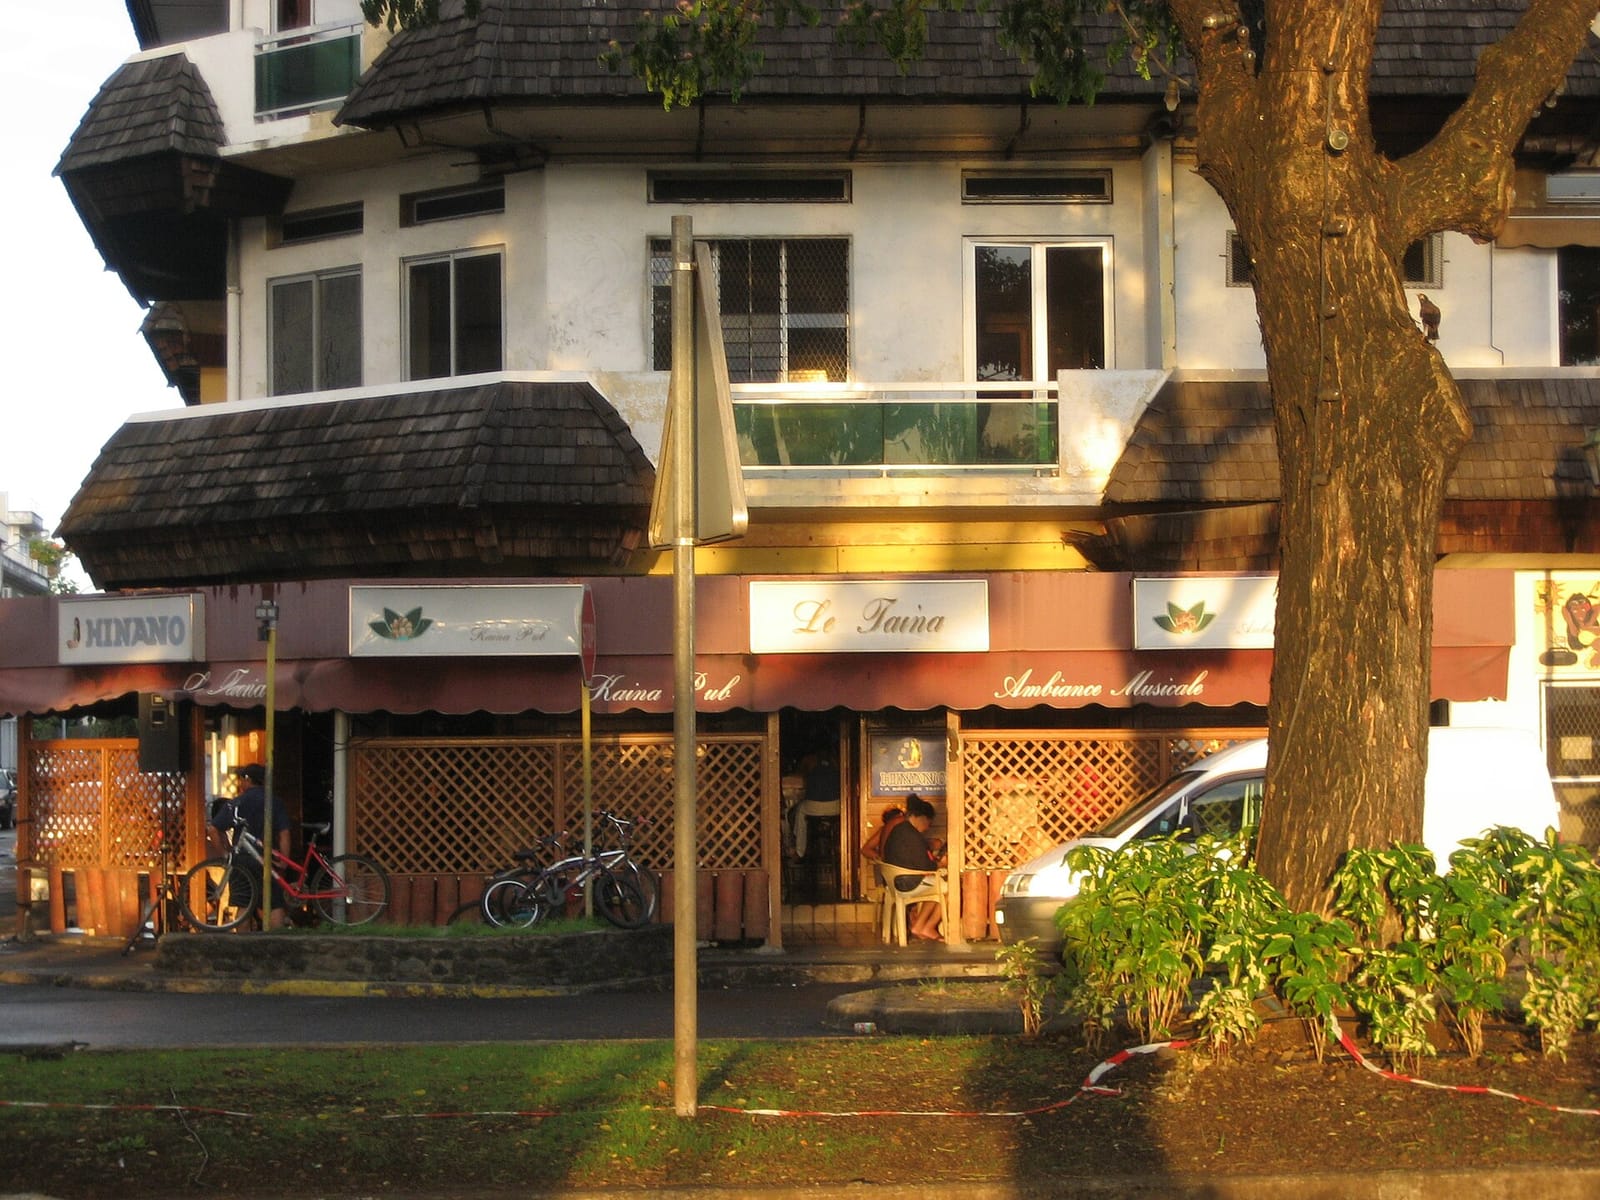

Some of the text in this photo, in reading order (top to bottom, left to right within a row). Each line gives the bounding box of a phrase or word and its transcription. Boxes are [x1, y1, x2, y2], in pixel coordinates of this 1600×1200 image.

[85, 615, 186, 648] HINANO
[793, 599, 836, 634] Le
[590, 674, 663, 702] Kaina
[994, 668, 1209, 698] Ambiance Musicale
